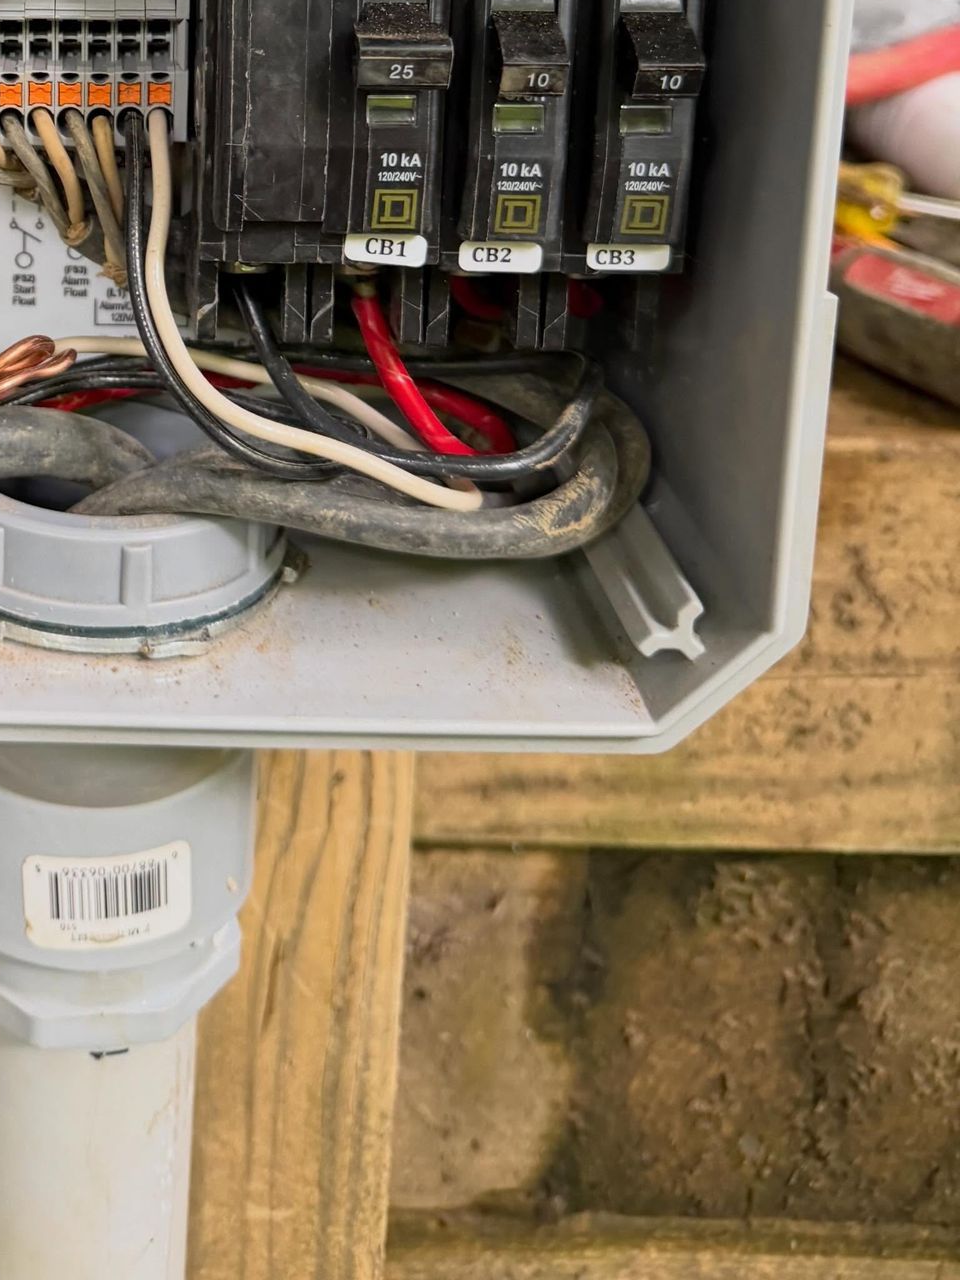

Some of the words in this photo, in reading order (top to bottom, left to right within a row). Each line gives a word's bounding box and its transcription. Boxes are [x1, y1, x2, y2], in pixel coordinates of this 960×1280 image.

[389, 65, 414, 80] 25
[526, 72, 550, 88] 10
[659, 74, 682, 90] 10
[379, 153, 398, 167] 10
[400, 153, 422, 168] kA
[500, 163, 517, 178] 10
[519, 163, 541, 178] kA
[628, 163, 646, 177] 10
[647, 163, 670, 178] kA
[364, 237, 408, 259] CB1
[471, 246, 513, 264] CB2
[595, 249, 636, 266] CB3
[61, 276, 90, 286] Alarm
[12, 284, 35, 294] Start
[64, 287, 88, 297] Float
[12, 296, 36, 306] Float
